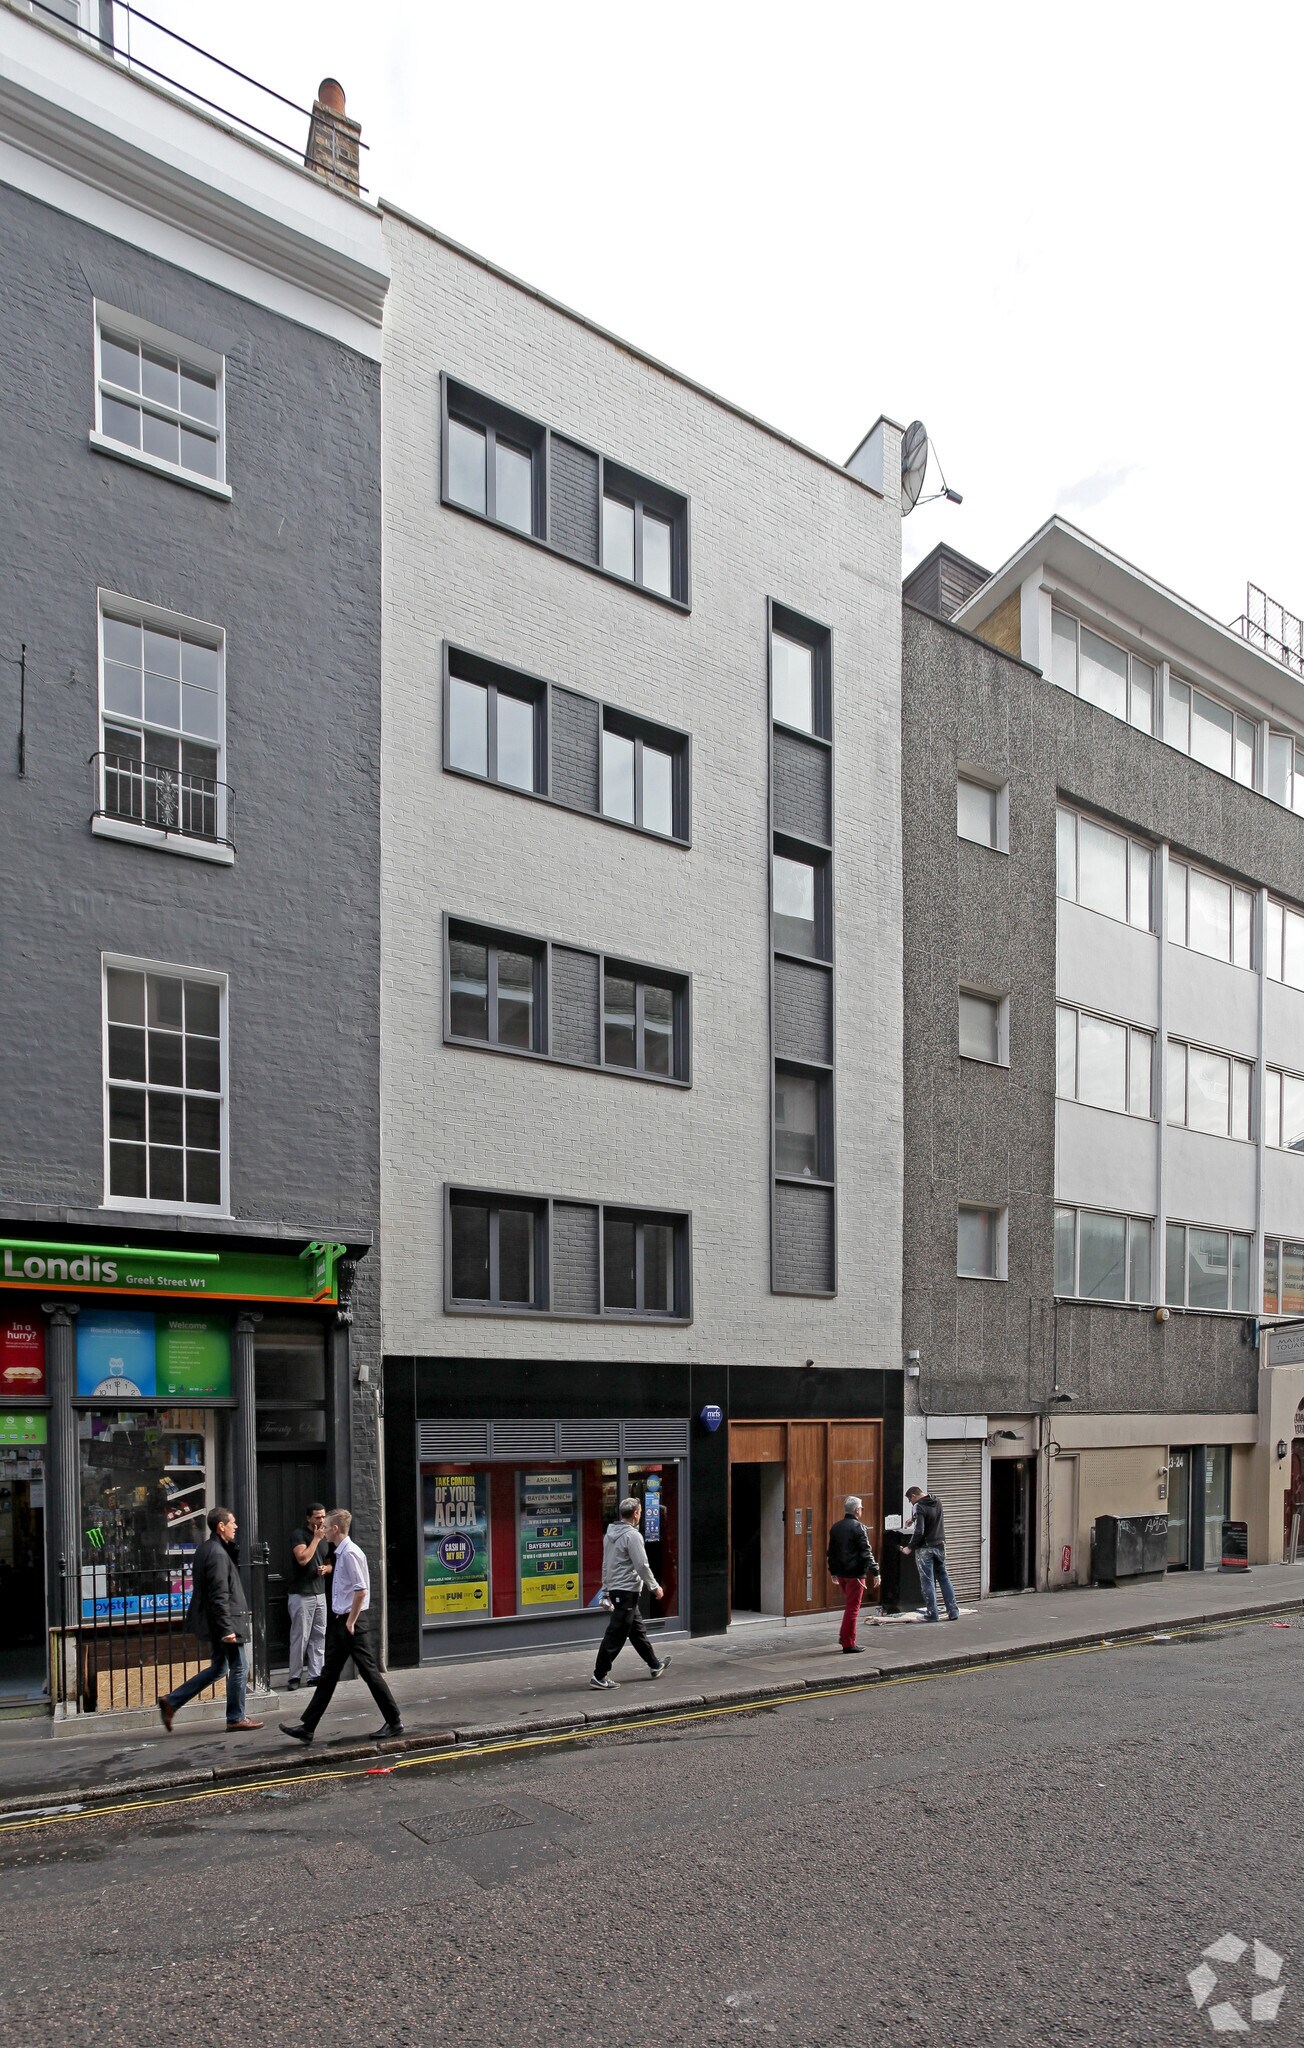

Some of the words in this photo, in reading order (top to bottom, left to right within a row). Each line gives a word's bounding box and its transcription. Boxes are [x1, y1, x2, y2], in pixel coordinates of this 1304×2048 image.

[4, 1250, 118, 1283] Londis
[126, 1275, 155, 1285] Greek
[157, 1276, 187, 1287] Street
[189, 1278, 206, 1287] W1
[13, 1322, 23, 1331] In
[168, 1321, 207, 1330] Welcome
[7, 1331, 37, 1341] hurry?
[707, 1409, 721, 1417] mrfs
[259, 1422, 292, 1436] Twenty
[435, 1477, 450, 1486] TAKE
[450, 1476, 476, 1486] CONTROL
[435, 1486, 447, 1502] OF
[449, 1486, 476, 1502] YOUR
[435, 1502, 477, 1527] ACCA
[536, 1507, 561, 1515] ARSENAL
[543, 1527, 558, 1536] 9/2
[445, 1543, 458, 1551] CASH
[459, 1543, 466, 1551] IN
[446, 1552, 455, 1560] MY
[456, 1552, 465, 1560] BET
[543, 1561, 557, 1570] 3/1
[446, 1592, 463, 1600] FUN
[95, 1600, 134, 1613] oyster
[140, 1596, 178, 1608] Ticket
